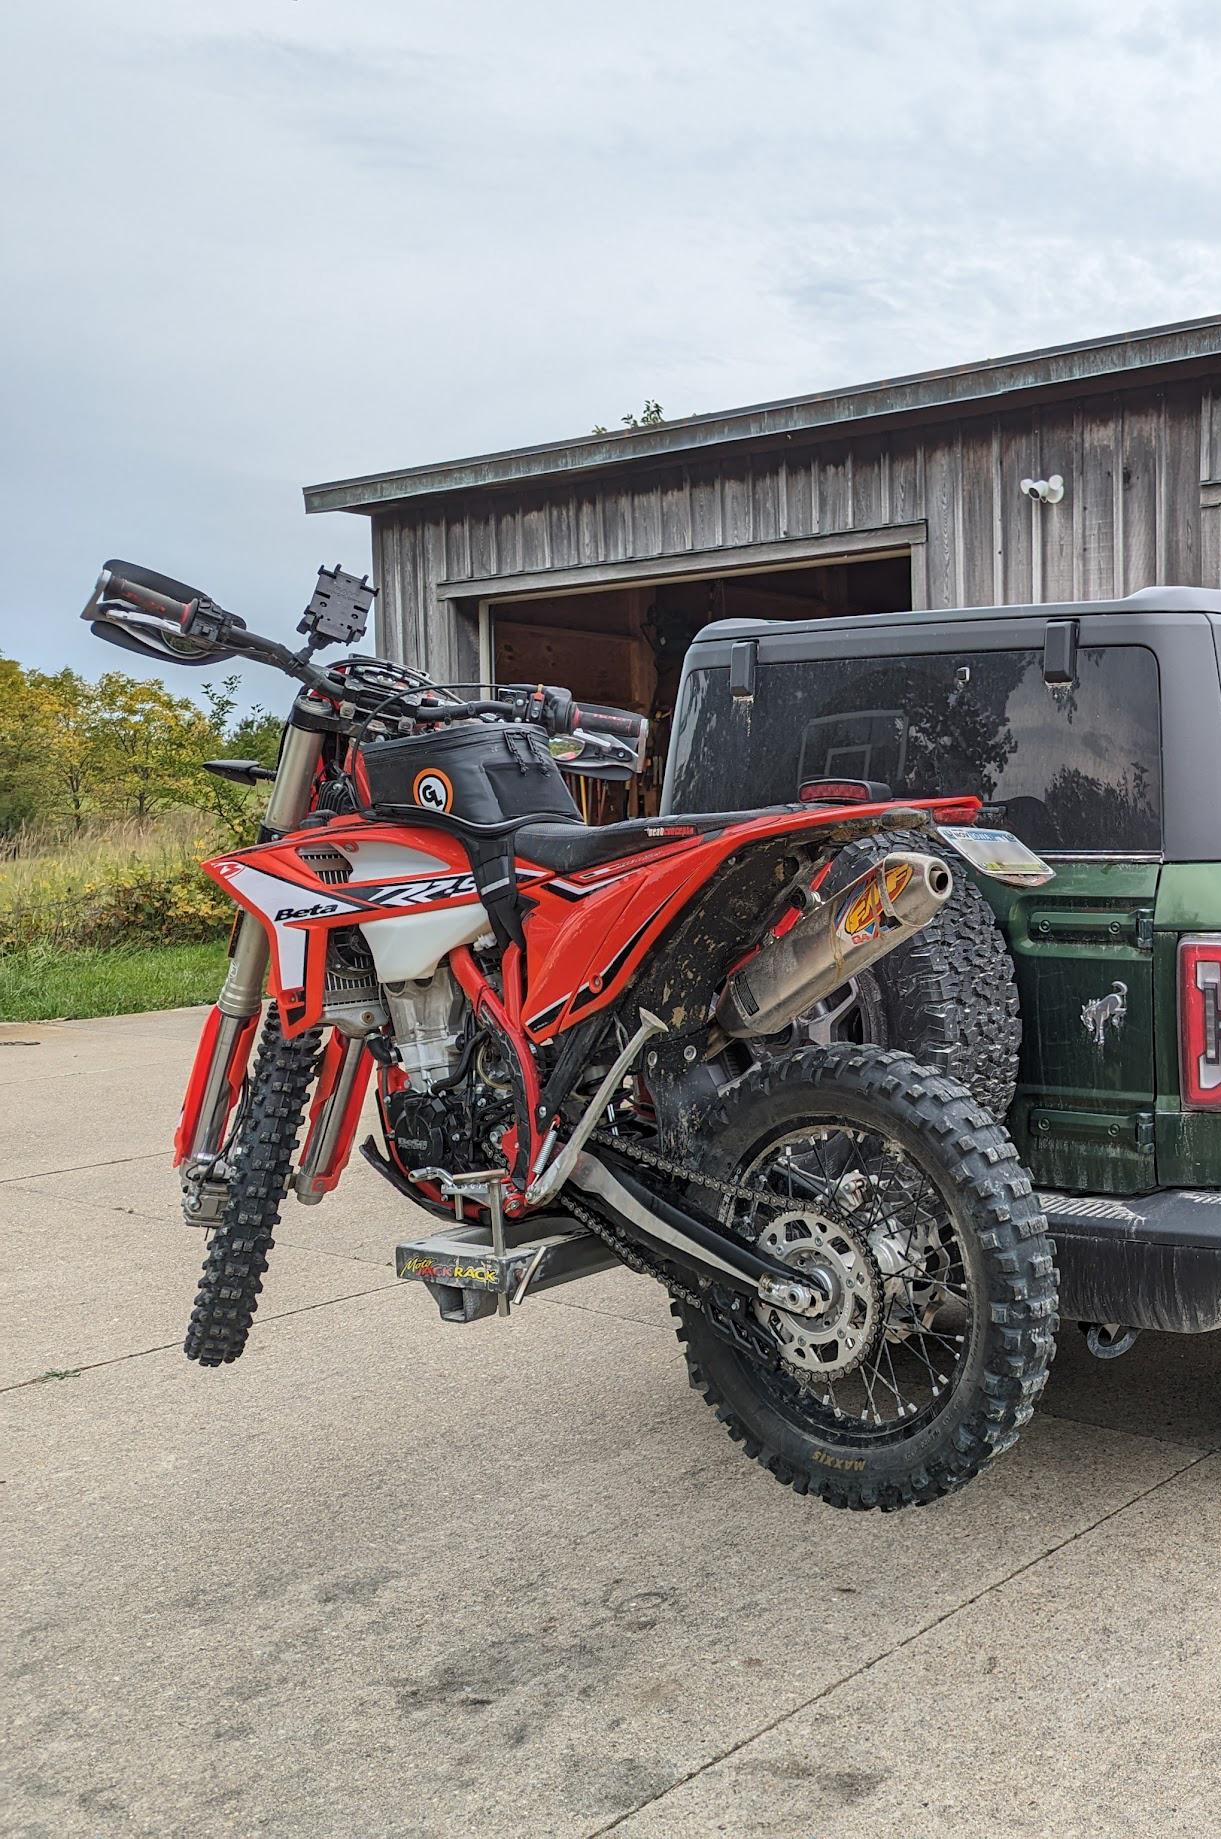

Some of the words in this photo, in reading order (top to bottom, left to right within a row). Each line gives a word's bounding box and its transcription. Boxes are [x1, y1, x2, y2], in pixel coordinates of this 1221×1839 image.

[422, 784, 444, 808] GL
[273, 903, 338, 922] Beta
[811, 1449, 866, 1472] MAXXIS
